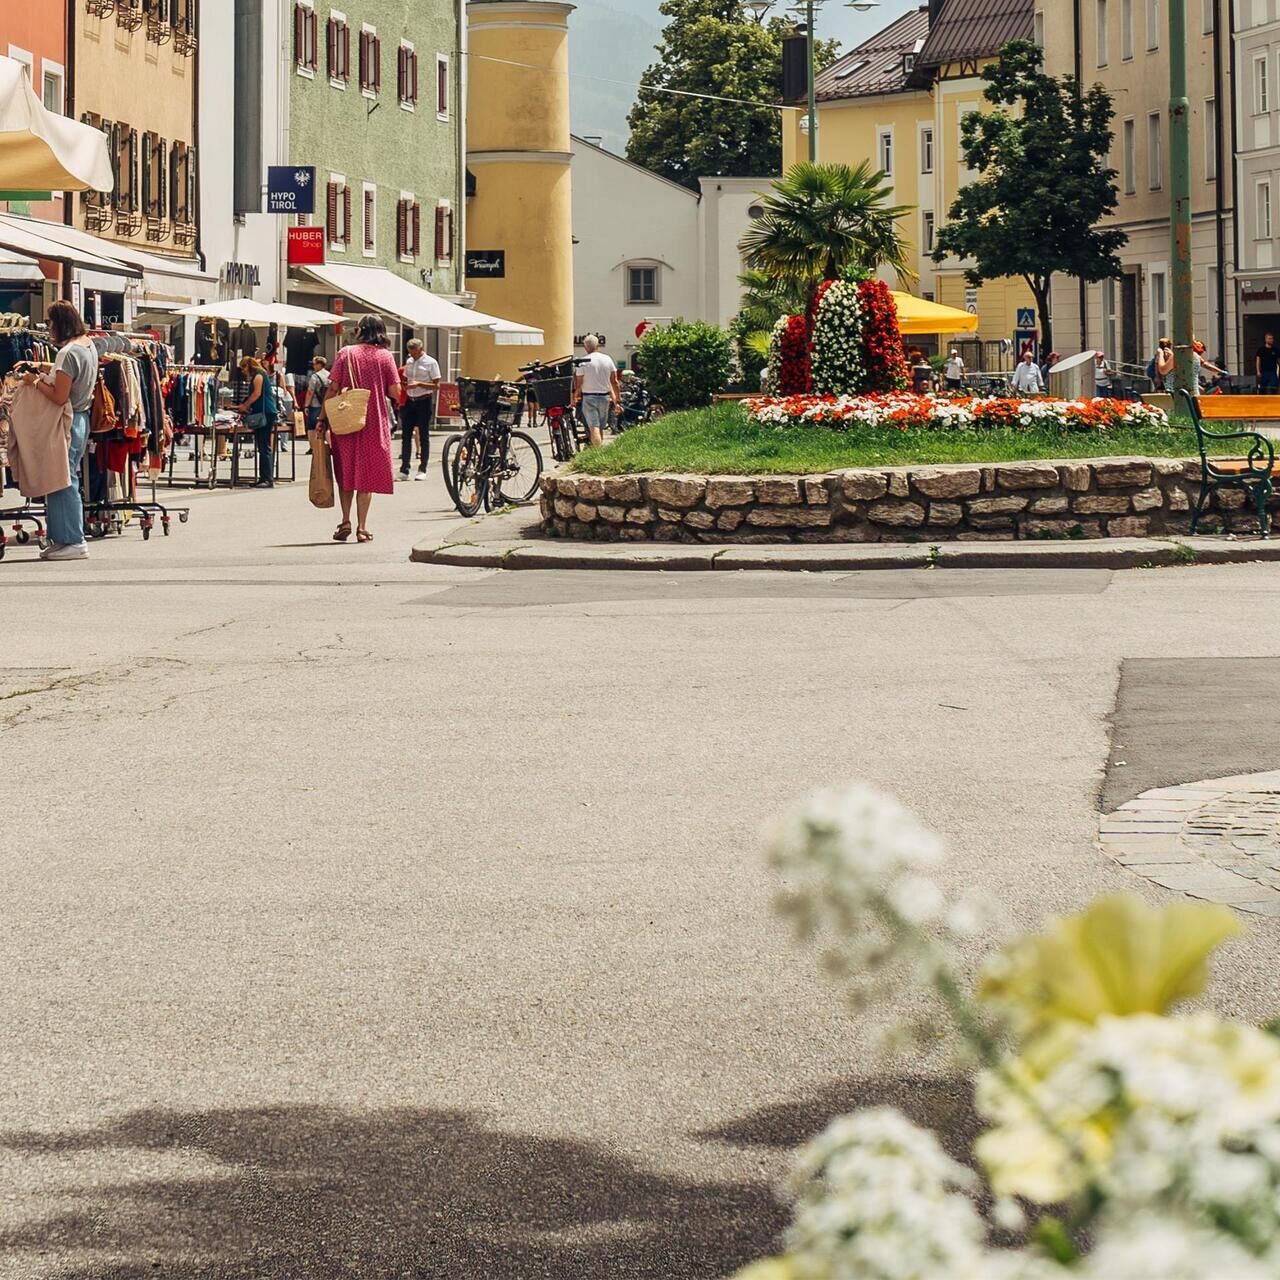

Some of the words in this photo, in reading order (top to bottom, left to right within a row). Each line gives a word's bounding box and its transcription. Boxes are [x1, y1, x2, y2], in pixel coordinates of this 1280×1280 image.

[271, 192, 296, 200] HYPO
[271, 201, 297, 209] TIROL
[289, 232, 322, 240] HUBER
[226, 262, 243, 285] HYPO
[244, 264, 261, 287] TIROL
